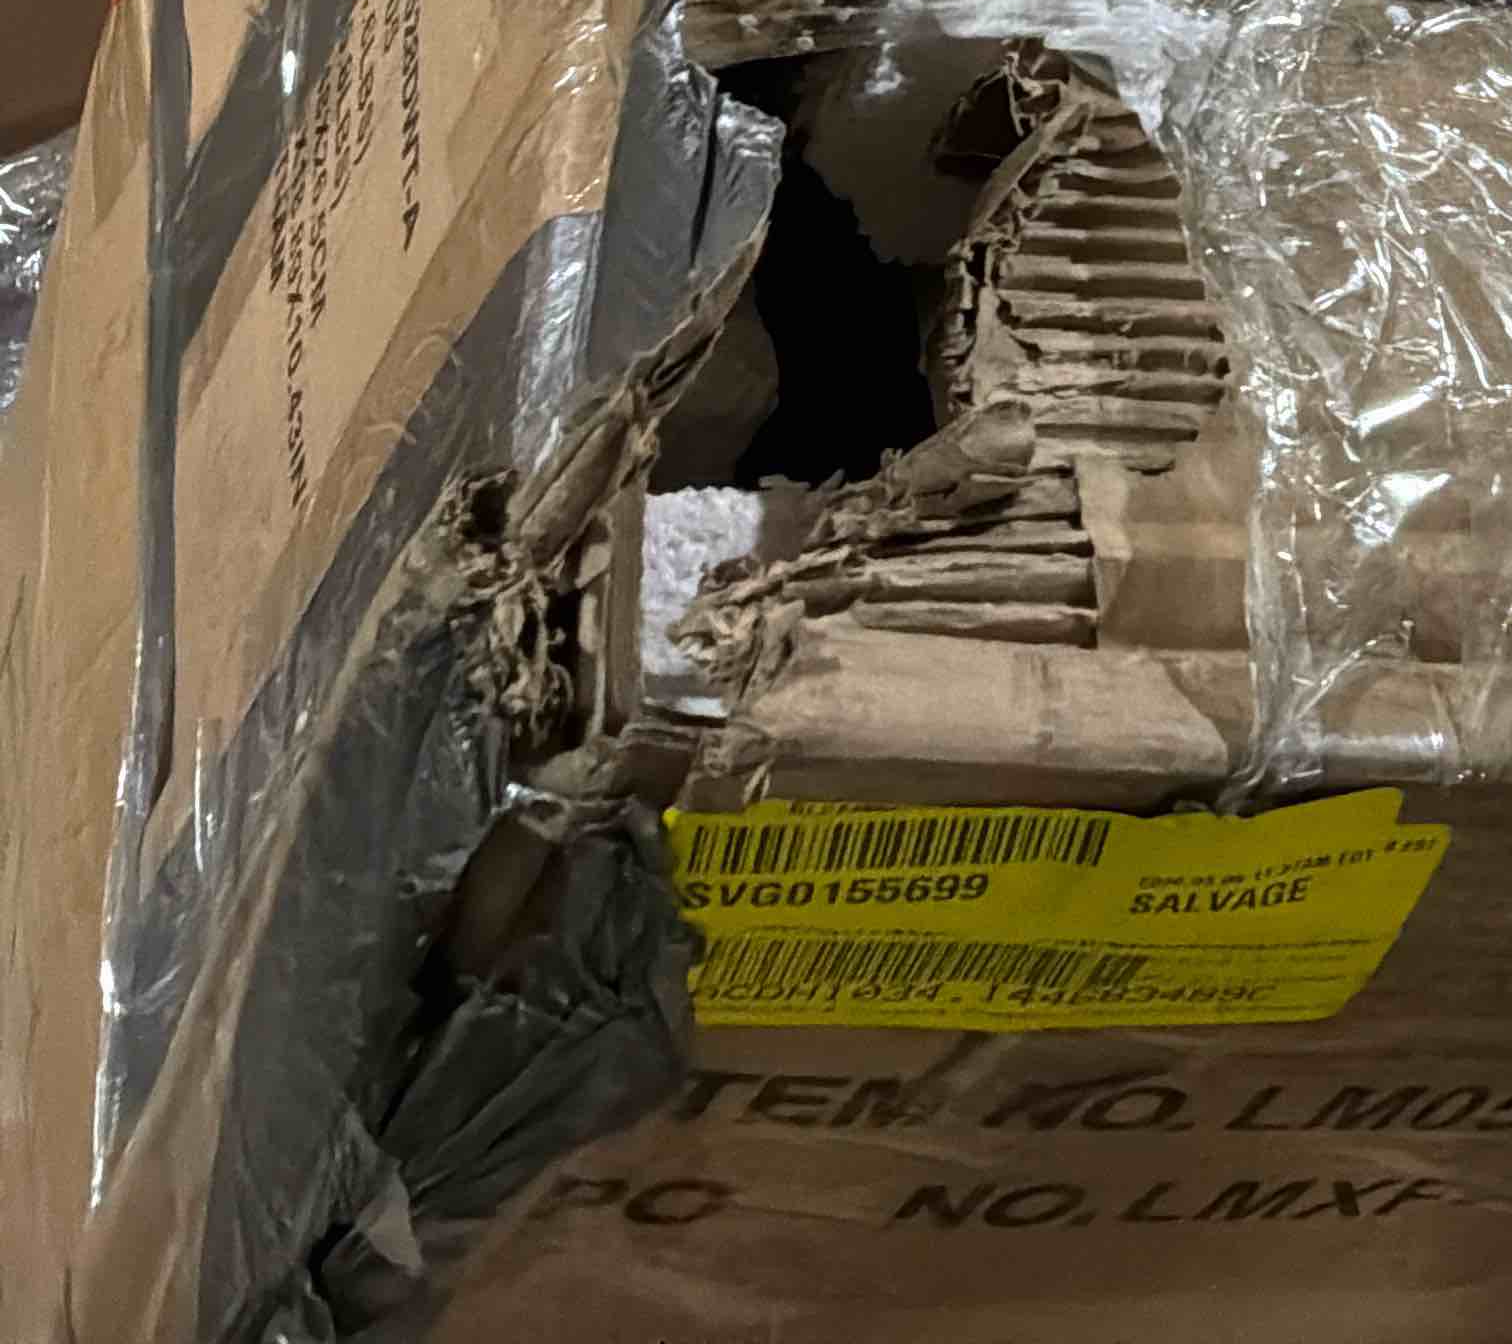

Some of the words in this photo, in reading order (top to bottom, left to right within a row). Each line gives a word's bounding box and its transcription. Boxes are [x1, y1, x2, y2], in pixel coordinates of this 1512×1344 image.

[680, 873, 990, 910] SVG0155699
[1130, 875, 1313, 914] SALVAGE
[669, 1068, 940, 1129] TEM
[885, 1181, 1096, 1228] NO.
